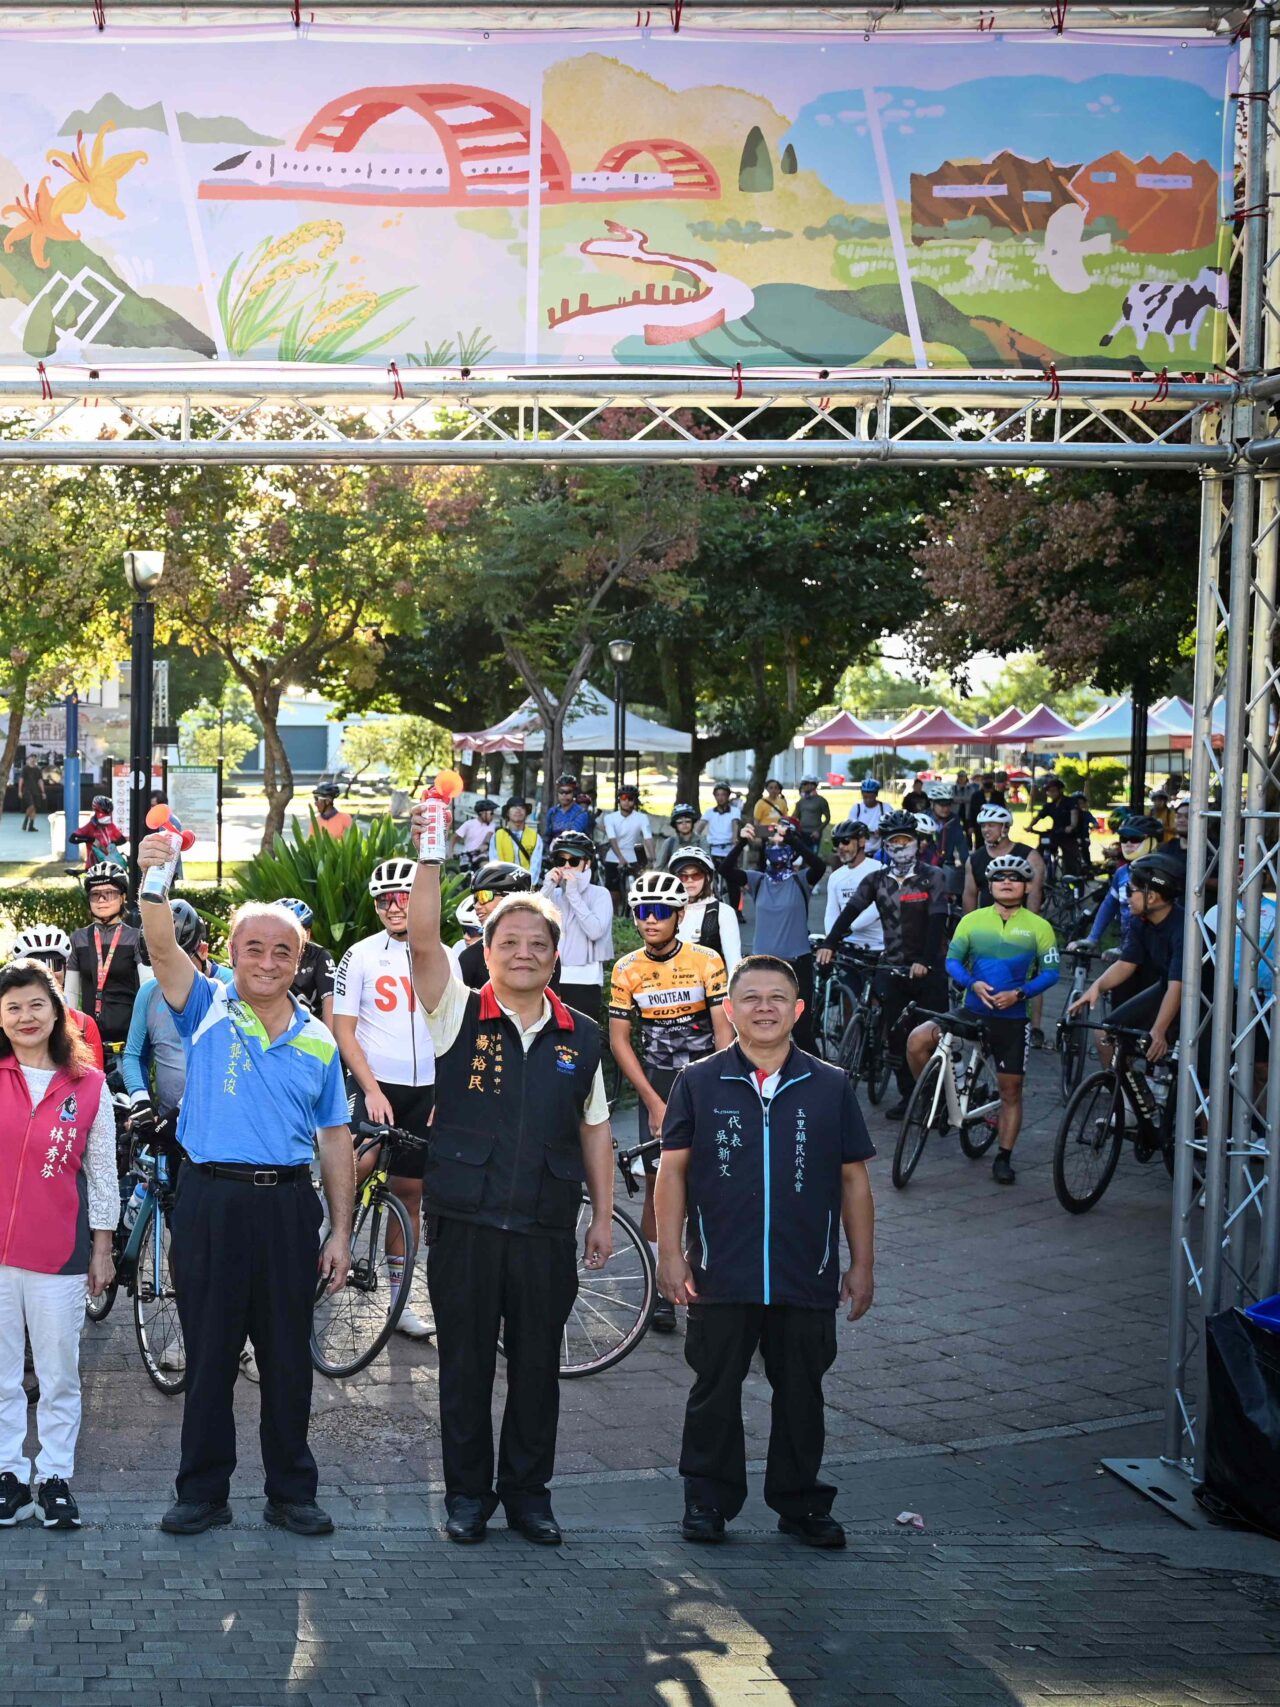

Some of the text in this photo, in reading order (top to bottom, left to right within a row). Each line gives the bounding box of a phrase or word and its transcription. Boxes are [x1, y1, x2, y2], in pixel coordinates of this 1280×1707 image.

[336, 950, 353, 997] RIEHLER
[648, 990, 691, 1006] POGITEAM
[653, 1005, 692, 1017] GUSTO
[467, 1034, 490, 1093] 楊裕民
[713, 1129, 732, 1178] 吳新文
[727, 1115, 743, 1147] 代表
[793, 1107, 807, 1193] 玉里鎮民代表會
